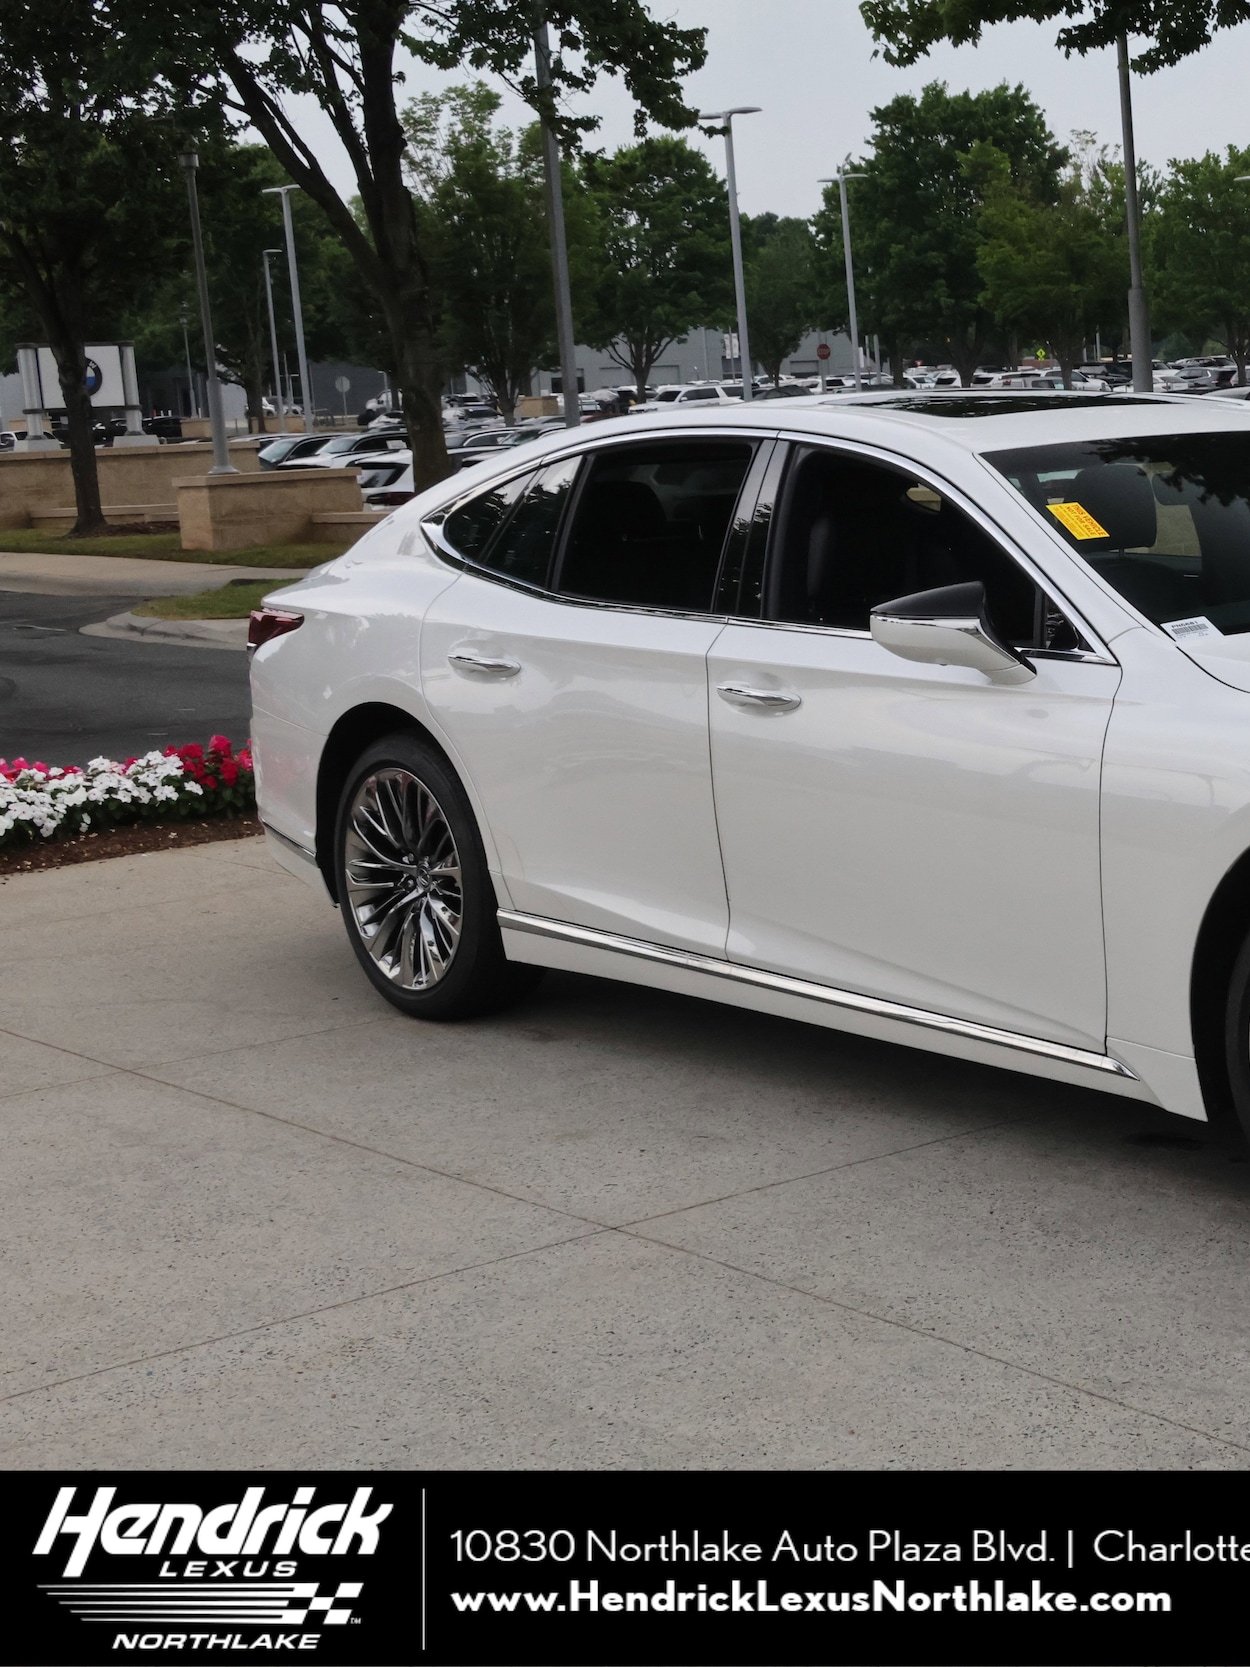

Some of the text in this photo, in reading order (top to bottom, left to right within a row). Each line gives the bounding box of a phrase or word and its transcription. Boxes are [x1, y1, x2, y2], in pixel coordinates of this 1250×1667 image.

[1066, 506, 1099, 536] NOT FOR SALE
[1083, 515, 1108, 537] VEHICLE
